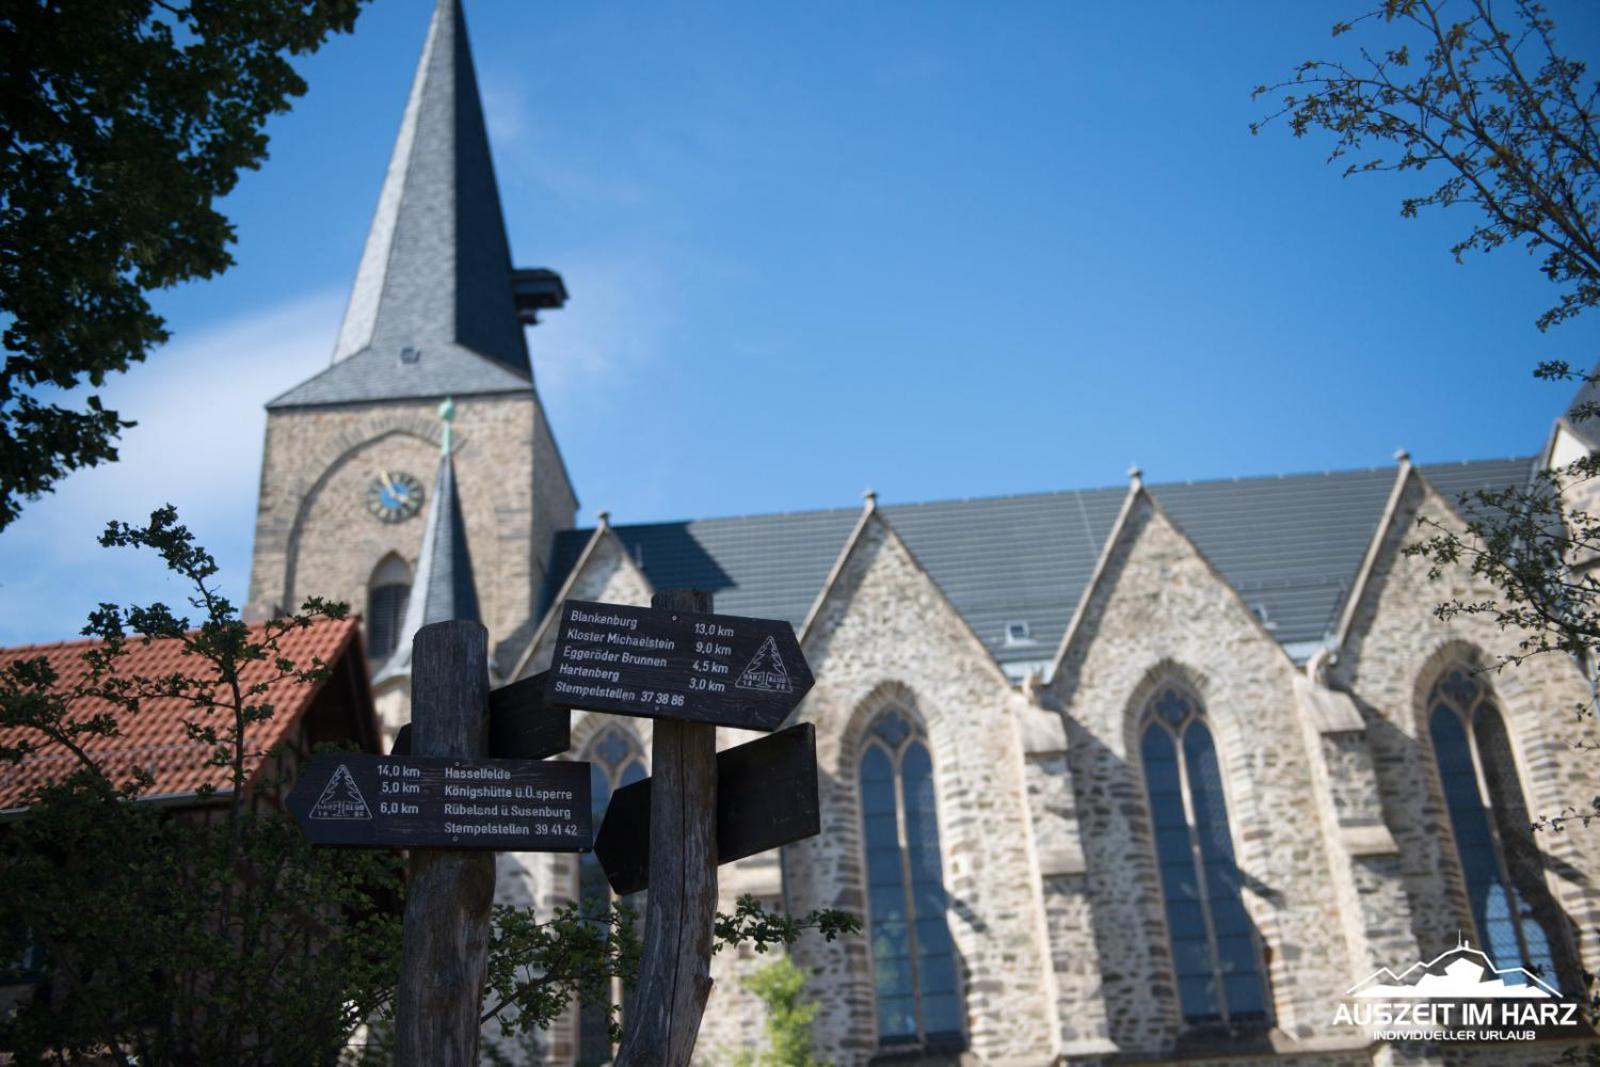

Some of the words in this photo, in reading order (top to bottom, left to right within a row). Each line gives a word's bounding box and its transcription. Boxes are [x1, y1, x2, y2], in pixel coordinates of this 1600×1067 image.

[571, 610, 638, 630] Blankenburg
[718, 625, 734, 638] km
[567, 628, 605, 642] Kloster
[607, 632, 675, 650] Michaelstein
[714, 644, 732, 656] km
[563, 646, 620, 661] Eggeröder
[622, 652, 668, 667] Brunnen
[711, 662, 728, 674] km
[560, 664, 620, 682] Hartenberg
[708, 680, 725, 692] km
[555, 681, 636, 700] Stempelstellen
[641, 691, 654, 702] 37
[656, 692, 669, 704] 38
[671, 694, 685, 706] 86
[402, 766, 420, 777] km
[445, 768, 511, 780] Hasselfelde
[402, 782, 420, 793] km
[444, 785, 512, 799] Königshütte
[401, 803, 418, 814] km
[444, 804, 498, 816] Rübeland
[511, 806, 571, 820] Susenburg
[444, 822, 530, 836] Stempelstellen
[534, 824, 548, 834] 39
[552, 824, 562, 835] 41
[564, 824, 578, 836] 42
